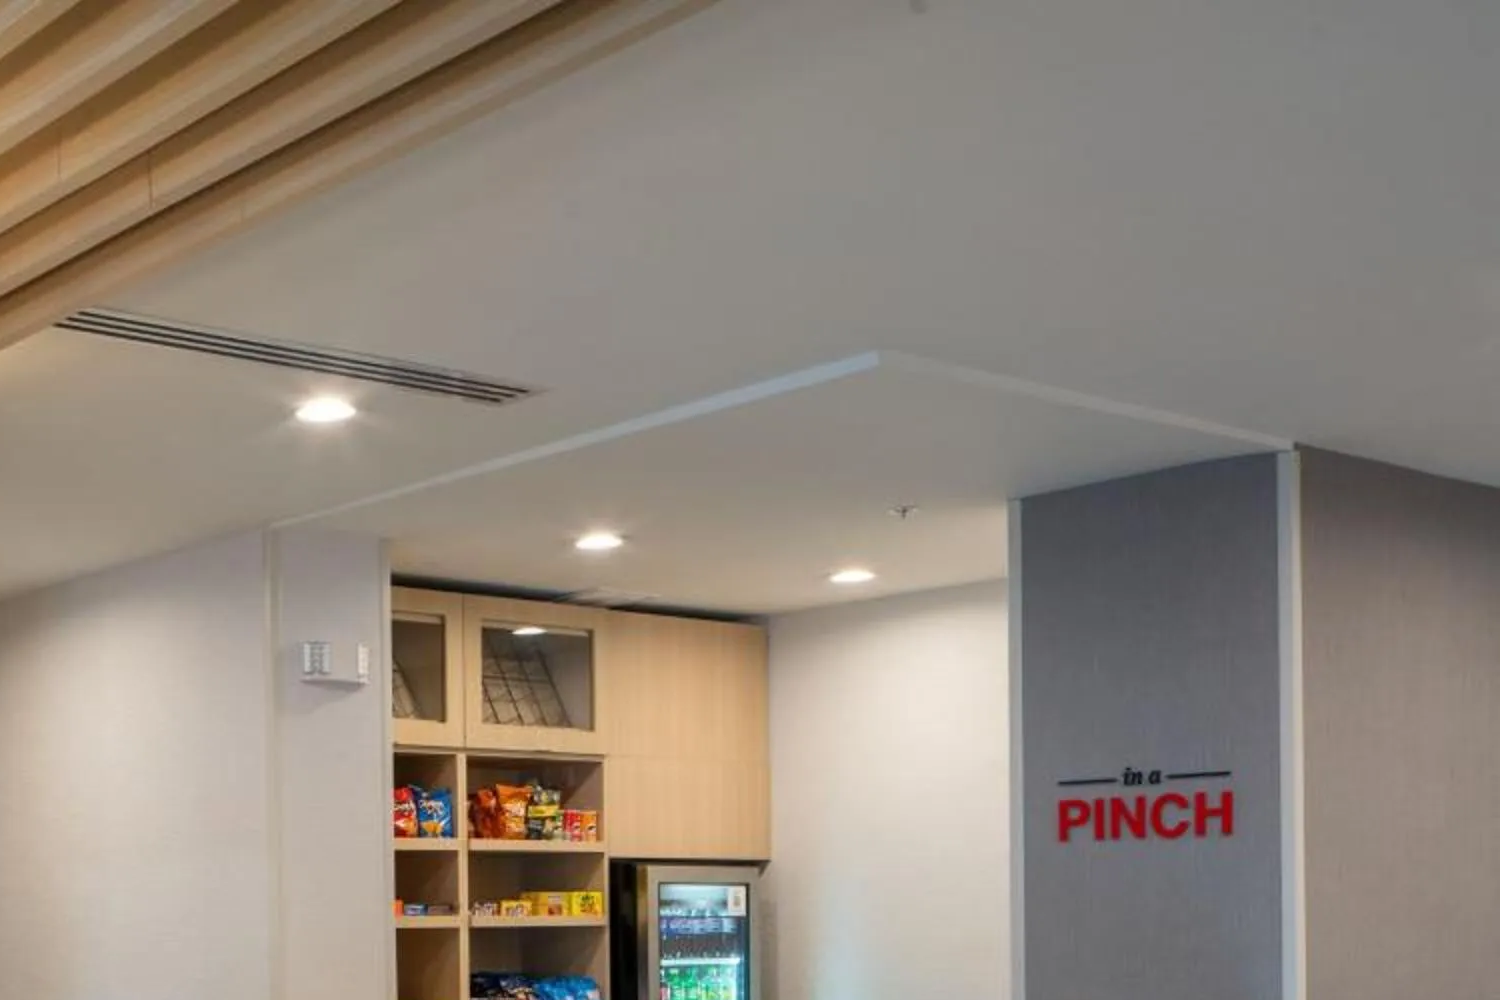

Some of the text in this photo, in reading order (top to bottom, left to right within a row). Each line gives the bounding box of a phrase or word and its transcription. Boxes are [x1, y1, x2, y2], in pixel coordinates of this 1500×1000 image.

[1122, 767, 1162, 786] in a
[1058, 790, 1234, 843] PINCH
